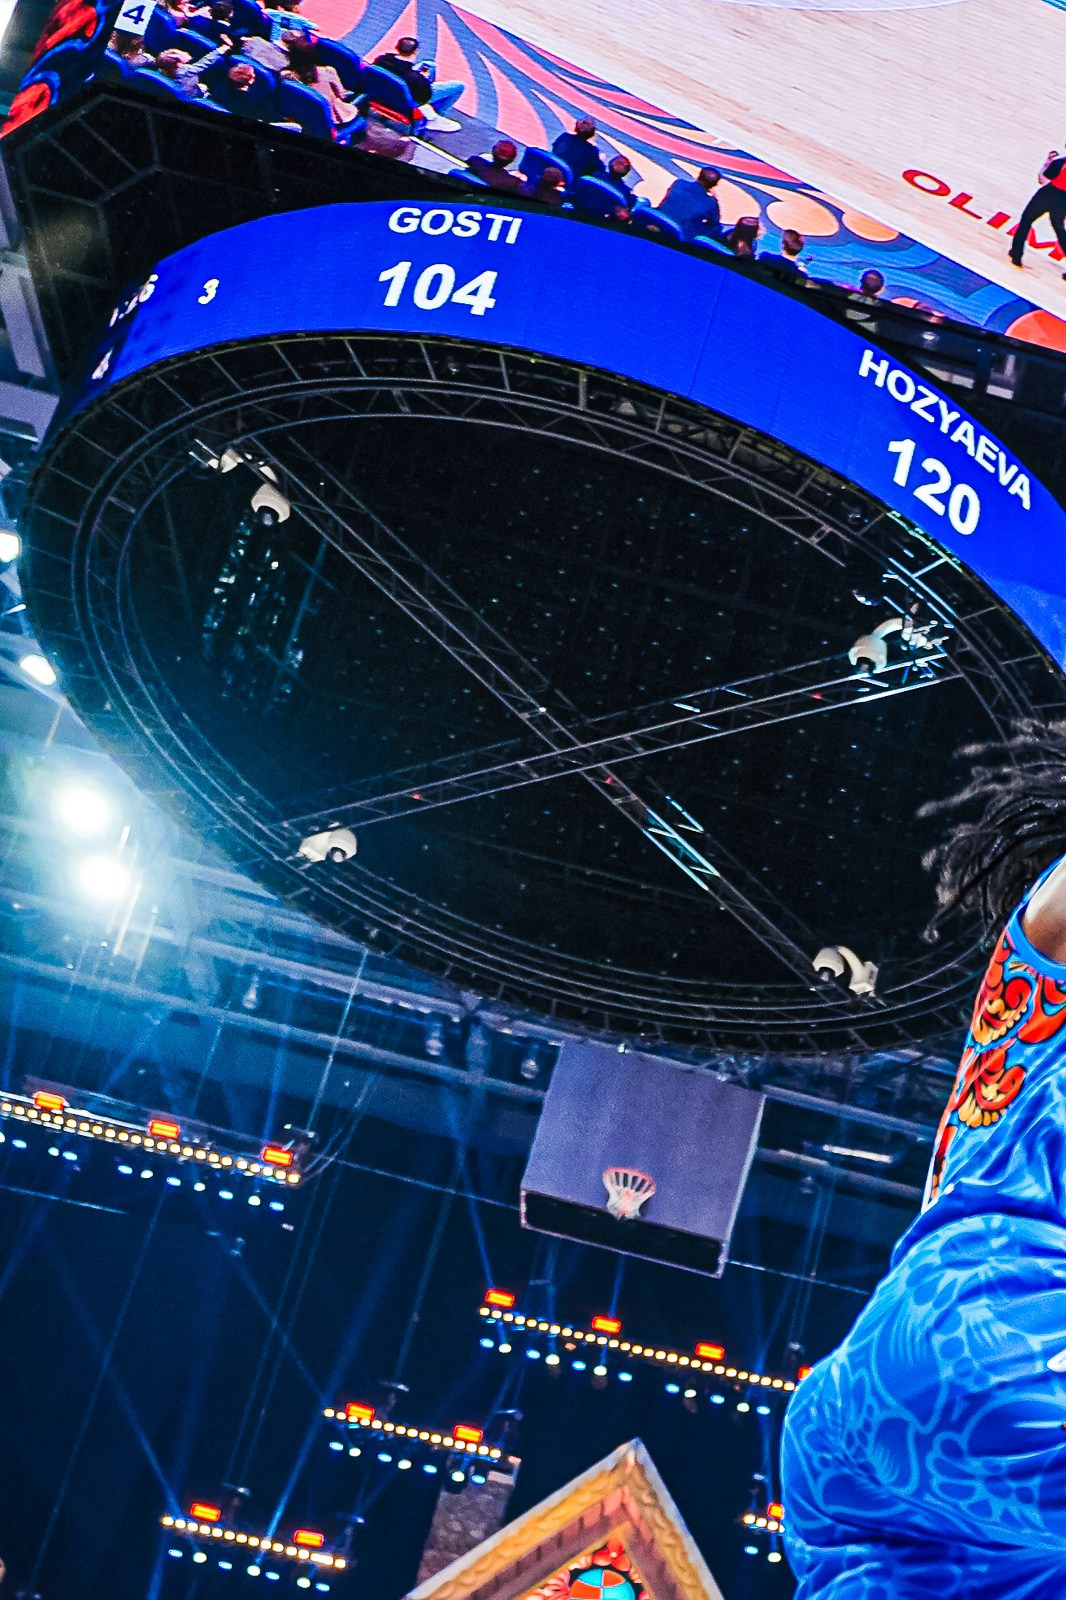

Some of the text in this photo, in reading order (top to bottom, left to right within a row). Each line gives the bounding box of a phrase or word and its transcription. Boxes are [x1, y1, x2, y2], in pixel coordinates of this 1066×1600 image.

[122, 4, 146, 25] 4
[388, 207, 523, 244] GOSTI
[198, 279, 220, 305] 3
[378, 261, 498, 316] 104
[858, 349, 1031, 511] HOZYAEVA
[888, 438, 981, 536] 120
